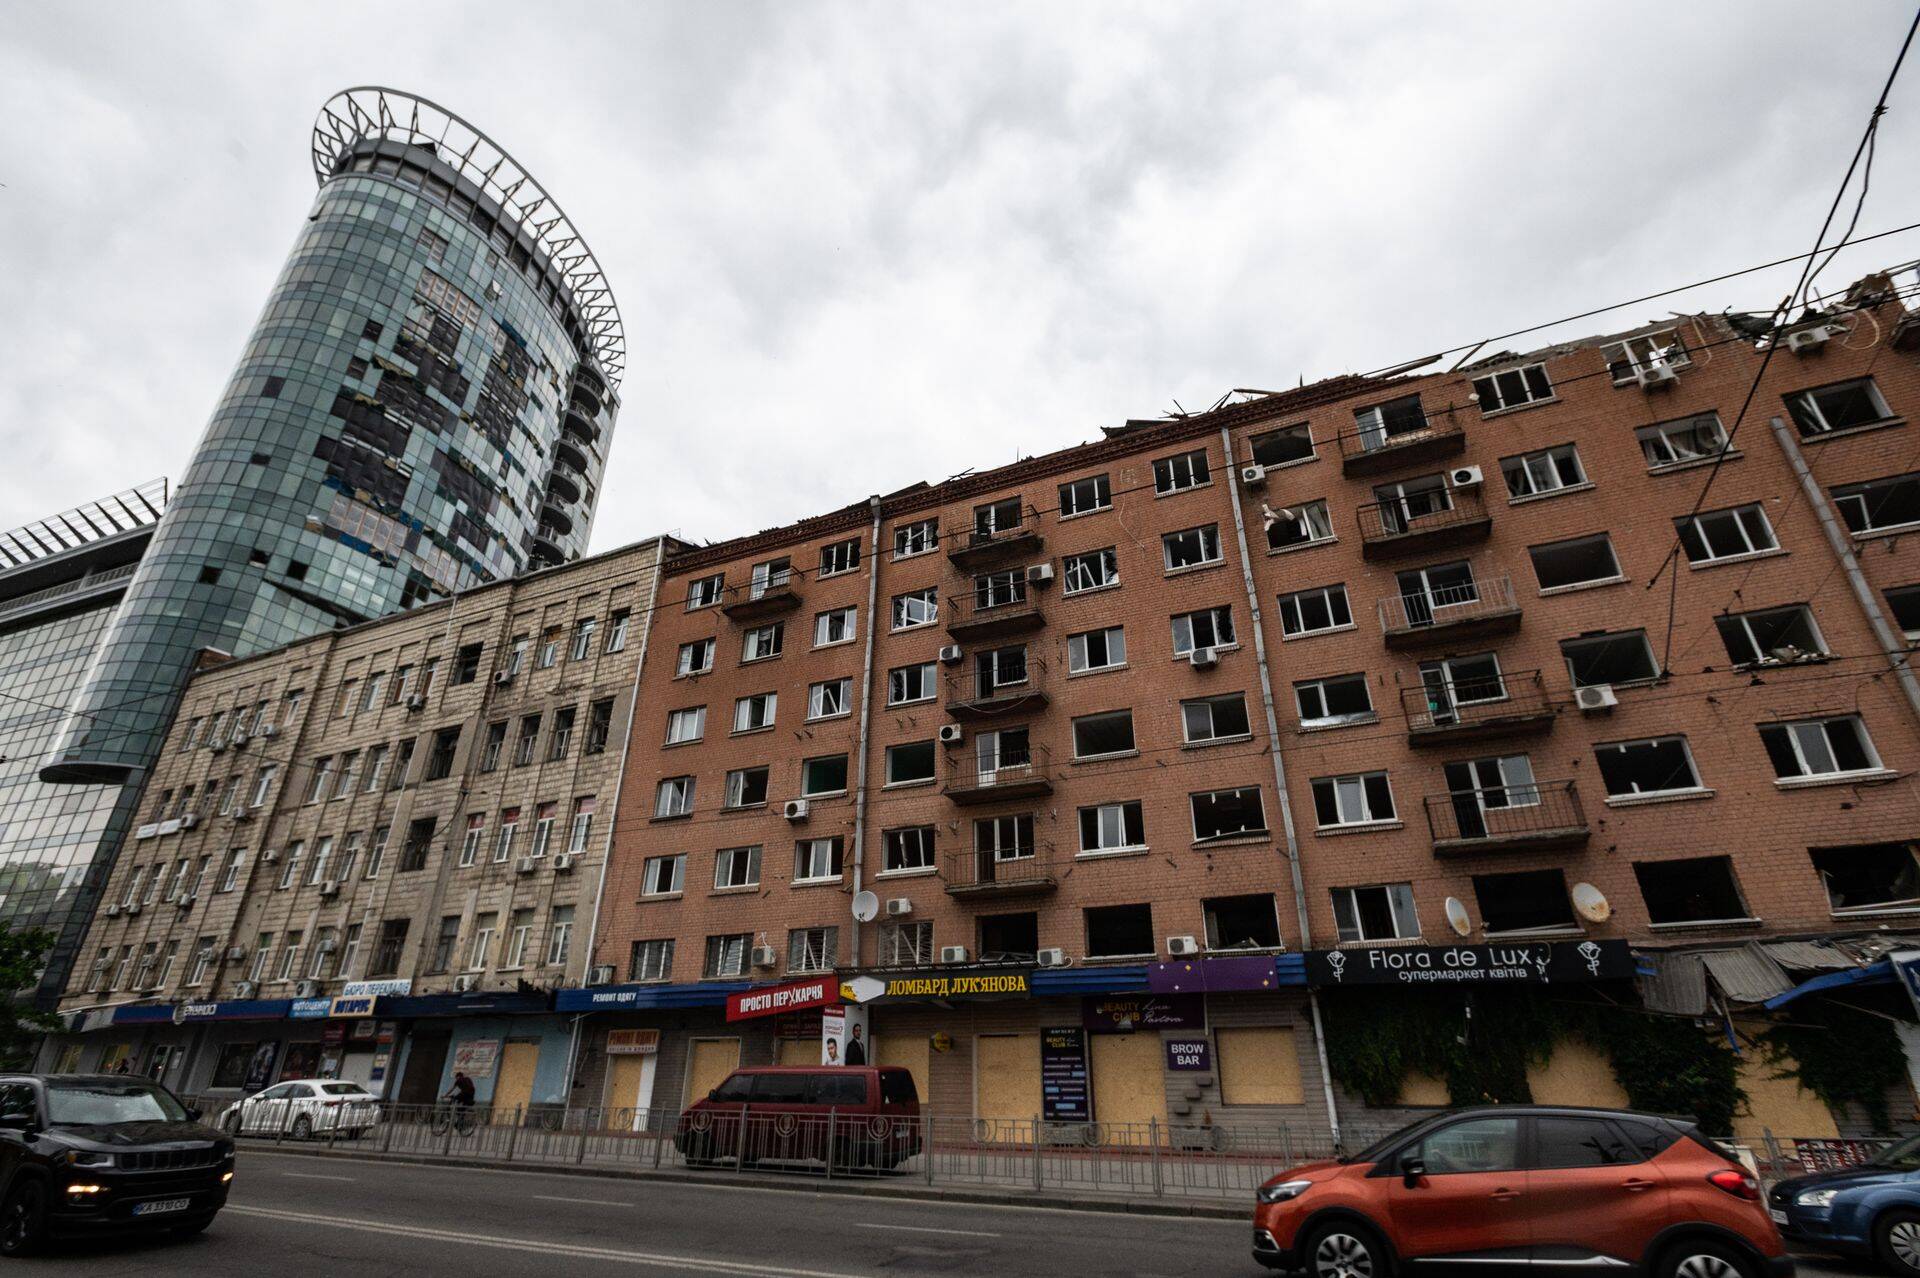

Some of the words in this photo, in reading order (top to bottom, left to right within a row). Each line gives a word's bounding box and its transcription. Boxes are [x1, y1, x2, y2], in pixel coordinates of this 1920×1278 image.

[1369, 950, 1431, 969] Flora
[1443, 949, 1477, 967] de
[1489, 949, 1533, 966] Lux
[1399, 969, 1485, 982] супермаркет
[1490, 967, 1528, 979] квітів
[887, 978, 949, 997] ЛОМБАРД
[593, 994, 616, 1002] РЕМОНТ
[740, 994, 772, 1013] ПРОСТО
[1112, 1011, 1141, 1023] CLUB
[1171, 1043, 1204, 1054] BROW
[1177, 1055, 1200, 1065] BAR
